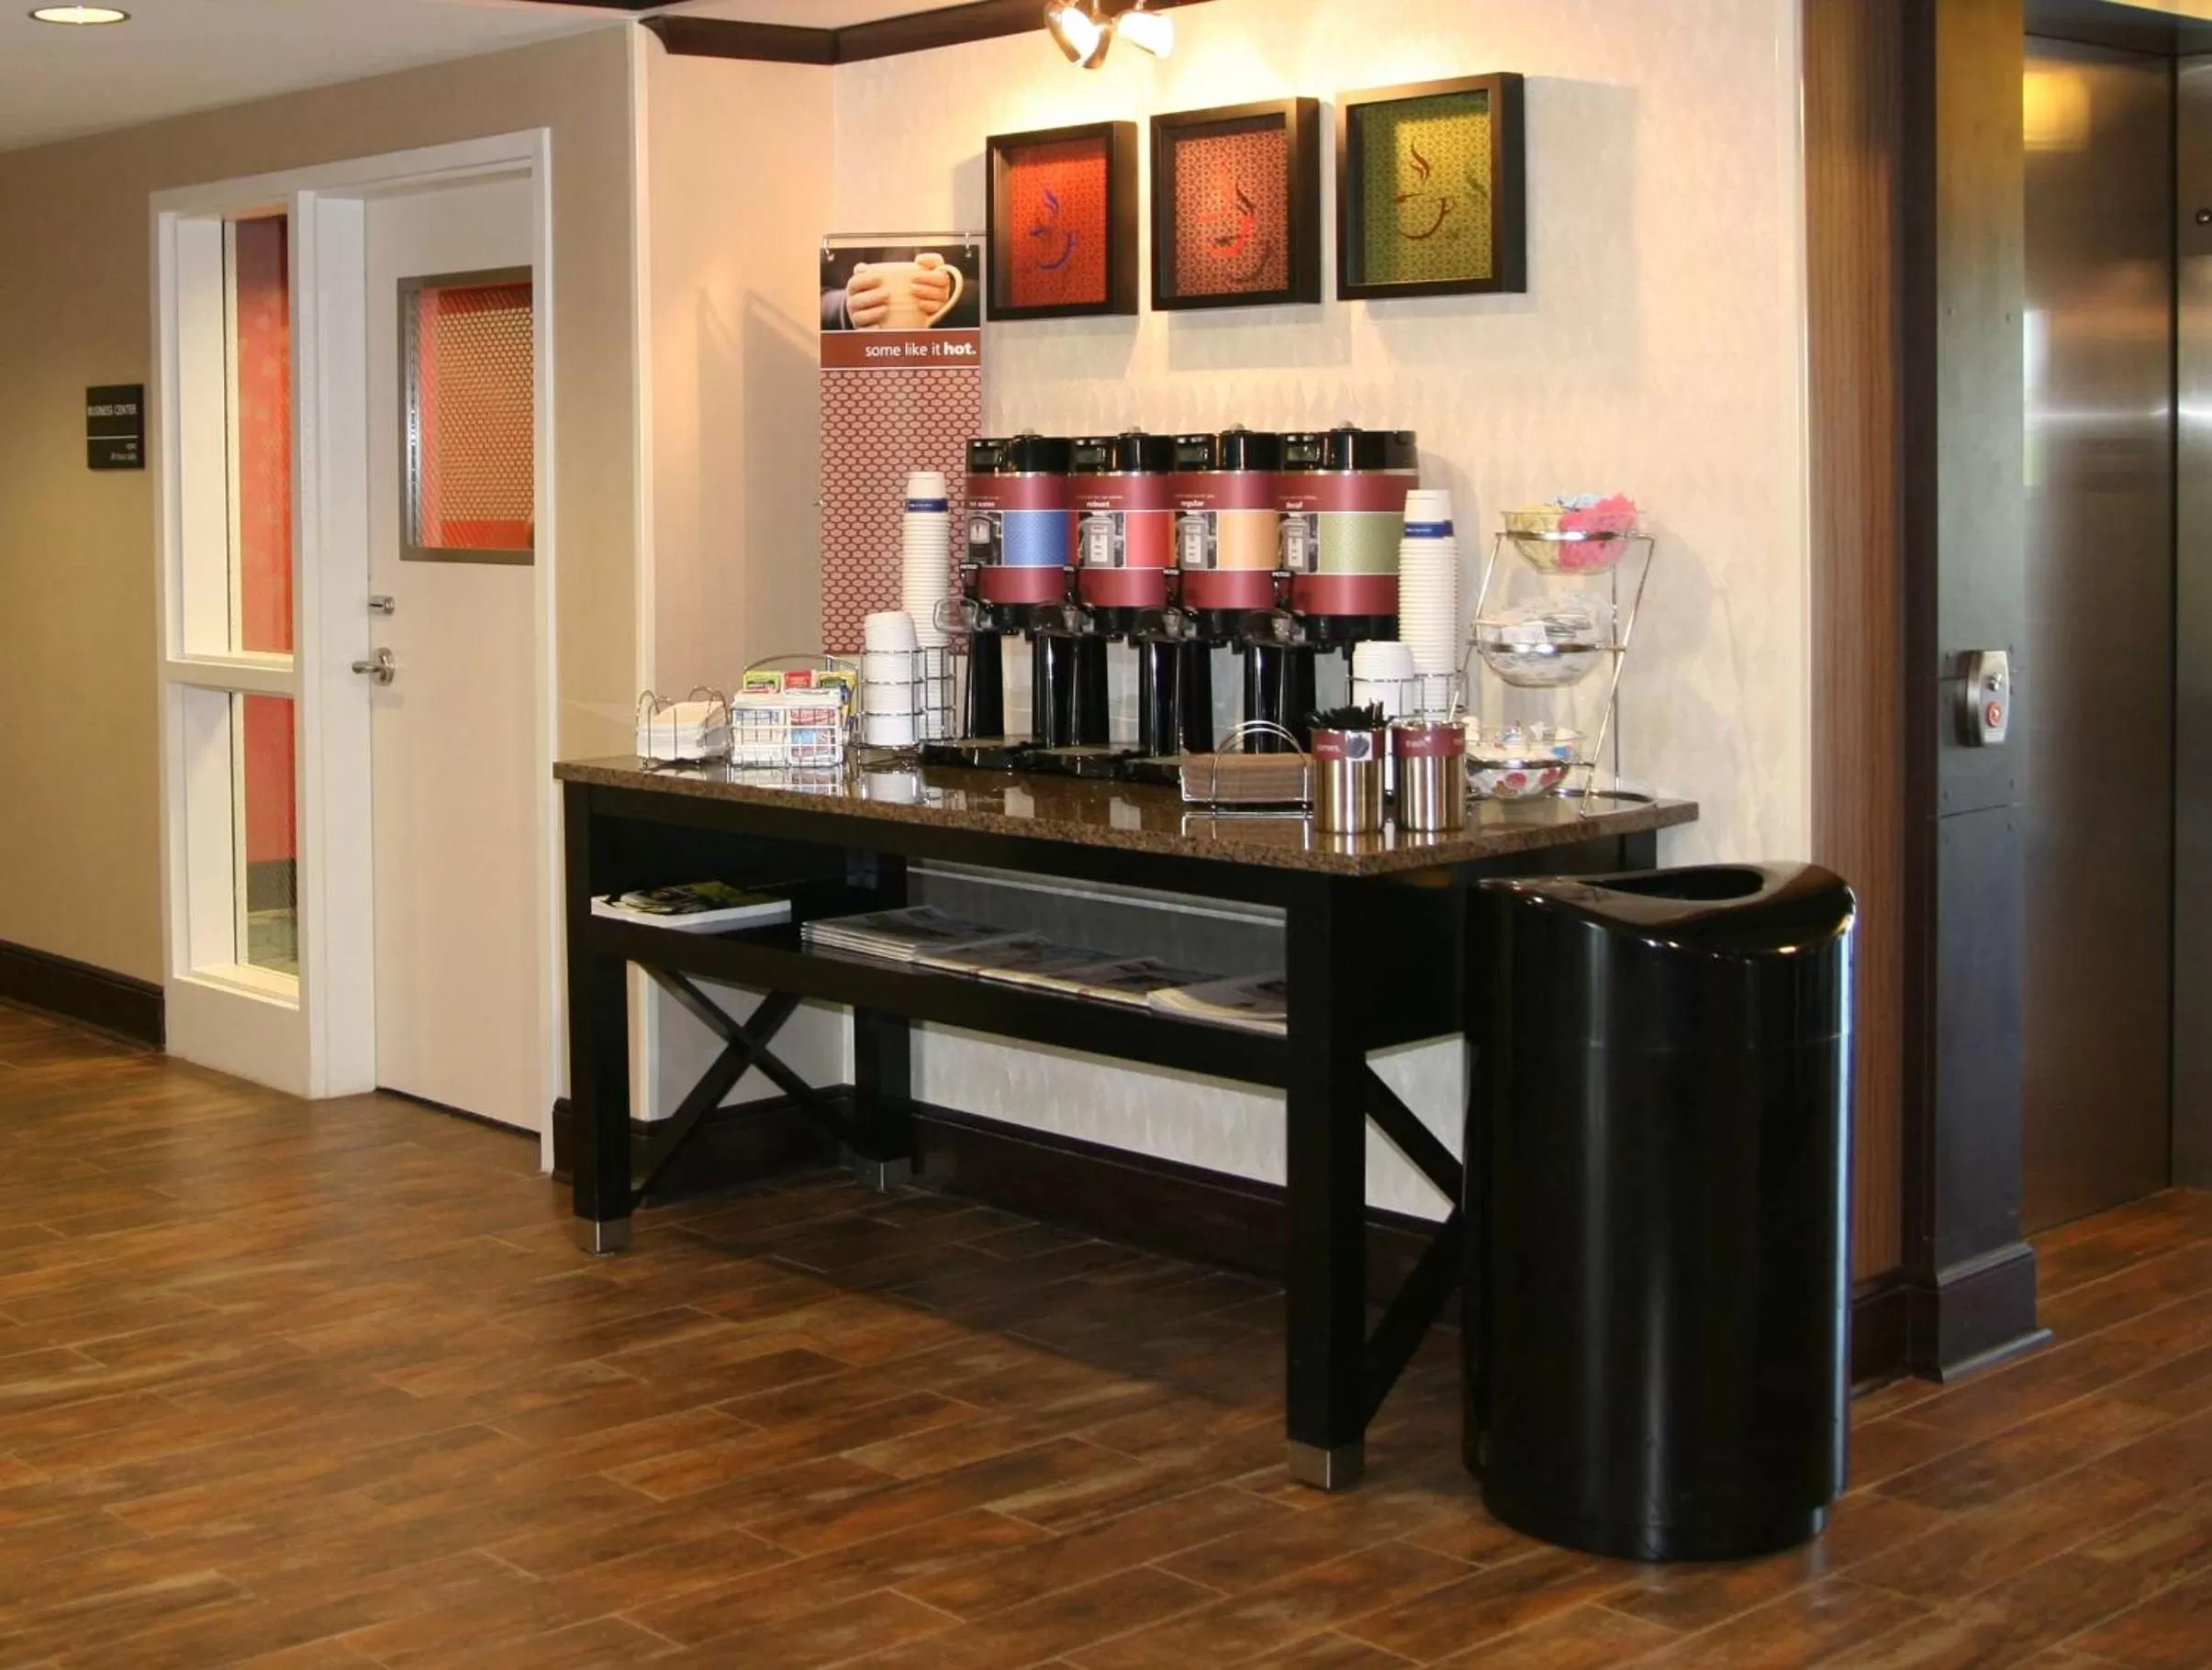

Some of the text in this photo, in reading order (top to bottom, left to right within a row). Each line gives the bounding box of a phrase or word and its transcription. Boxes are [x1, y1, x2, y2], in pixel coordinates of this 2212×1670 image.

[865, 340, 977, 357] some like it hot.
